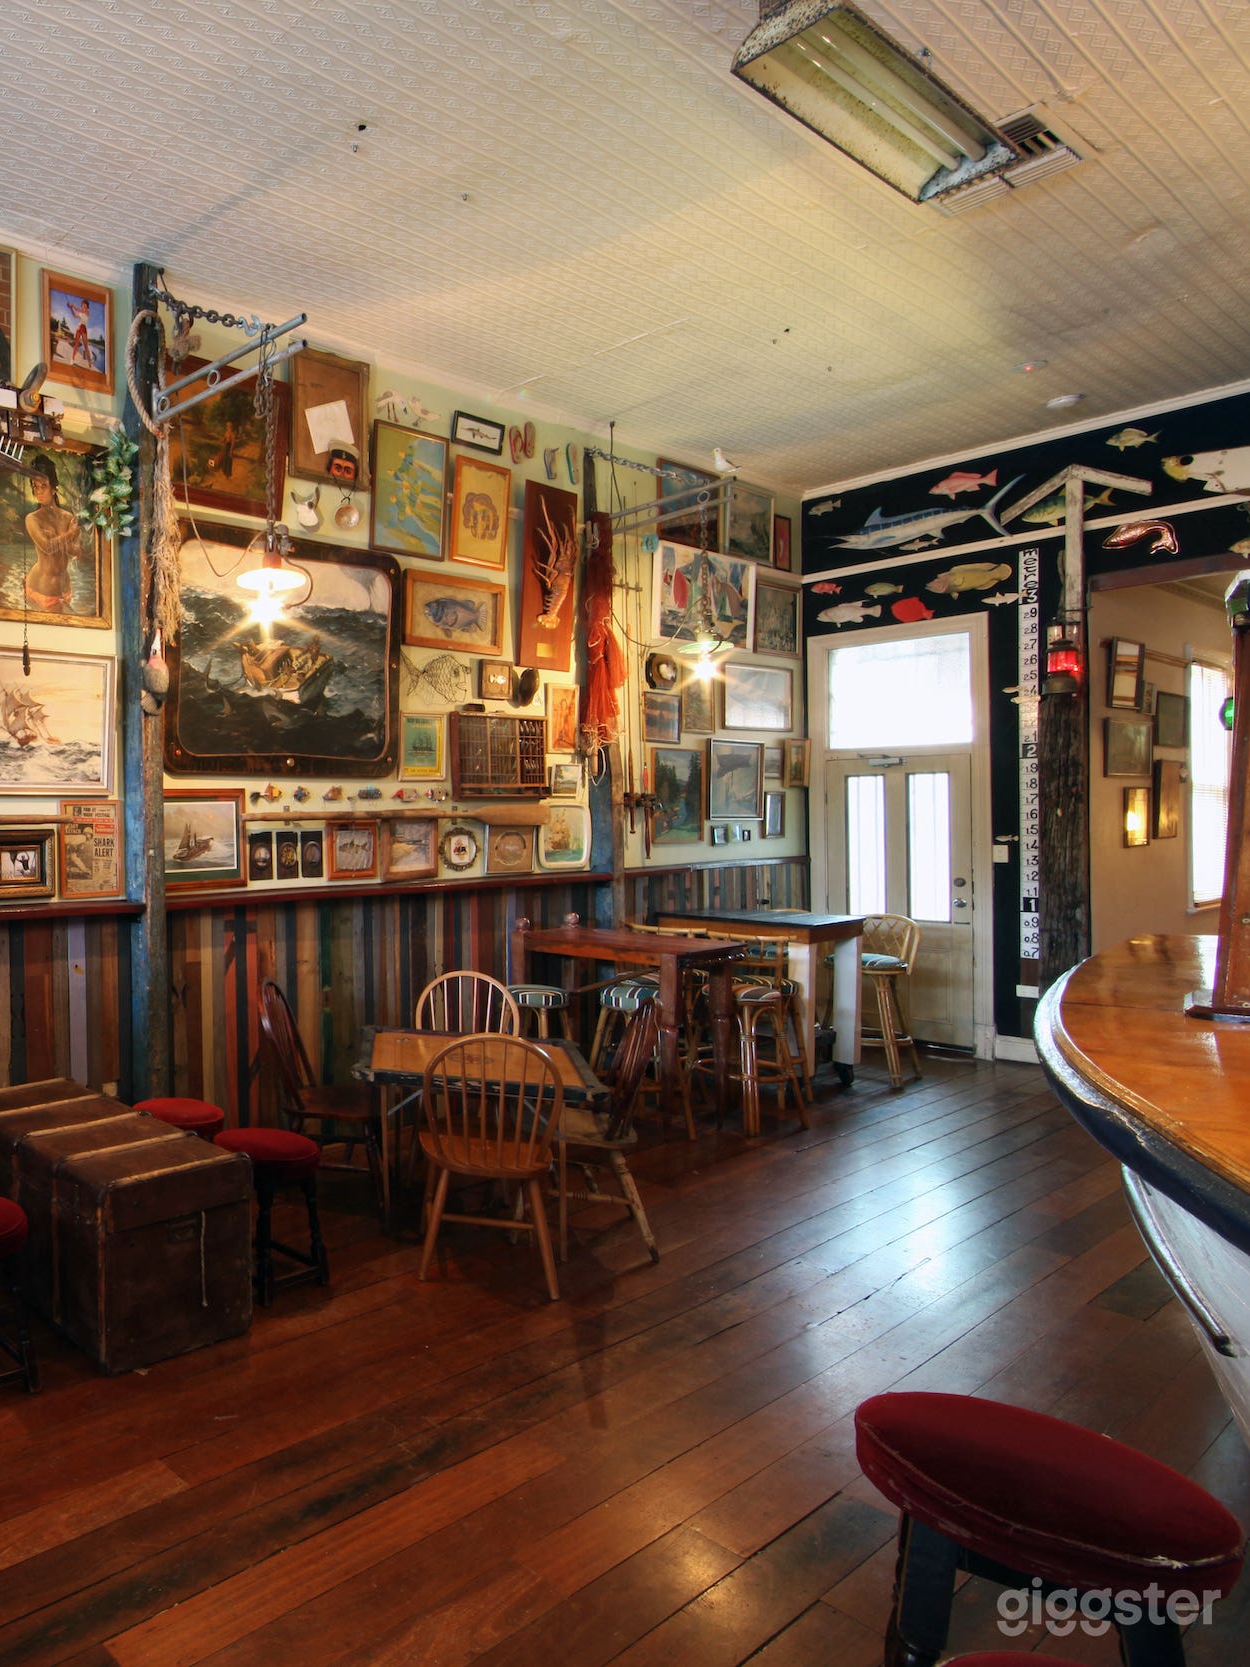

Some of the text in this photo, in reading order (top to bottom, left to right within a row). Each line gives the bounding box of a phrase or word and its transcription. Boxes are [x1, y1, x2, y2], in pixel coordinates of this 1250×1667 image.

[1027, 589, 1038, 604] 3
[1026, 744, 1037, 757] 2
[94, 838, 115, 848] SHARK
[94, 847, 114, 857] ALERT
[1029, 899, 1036, 911] 1
